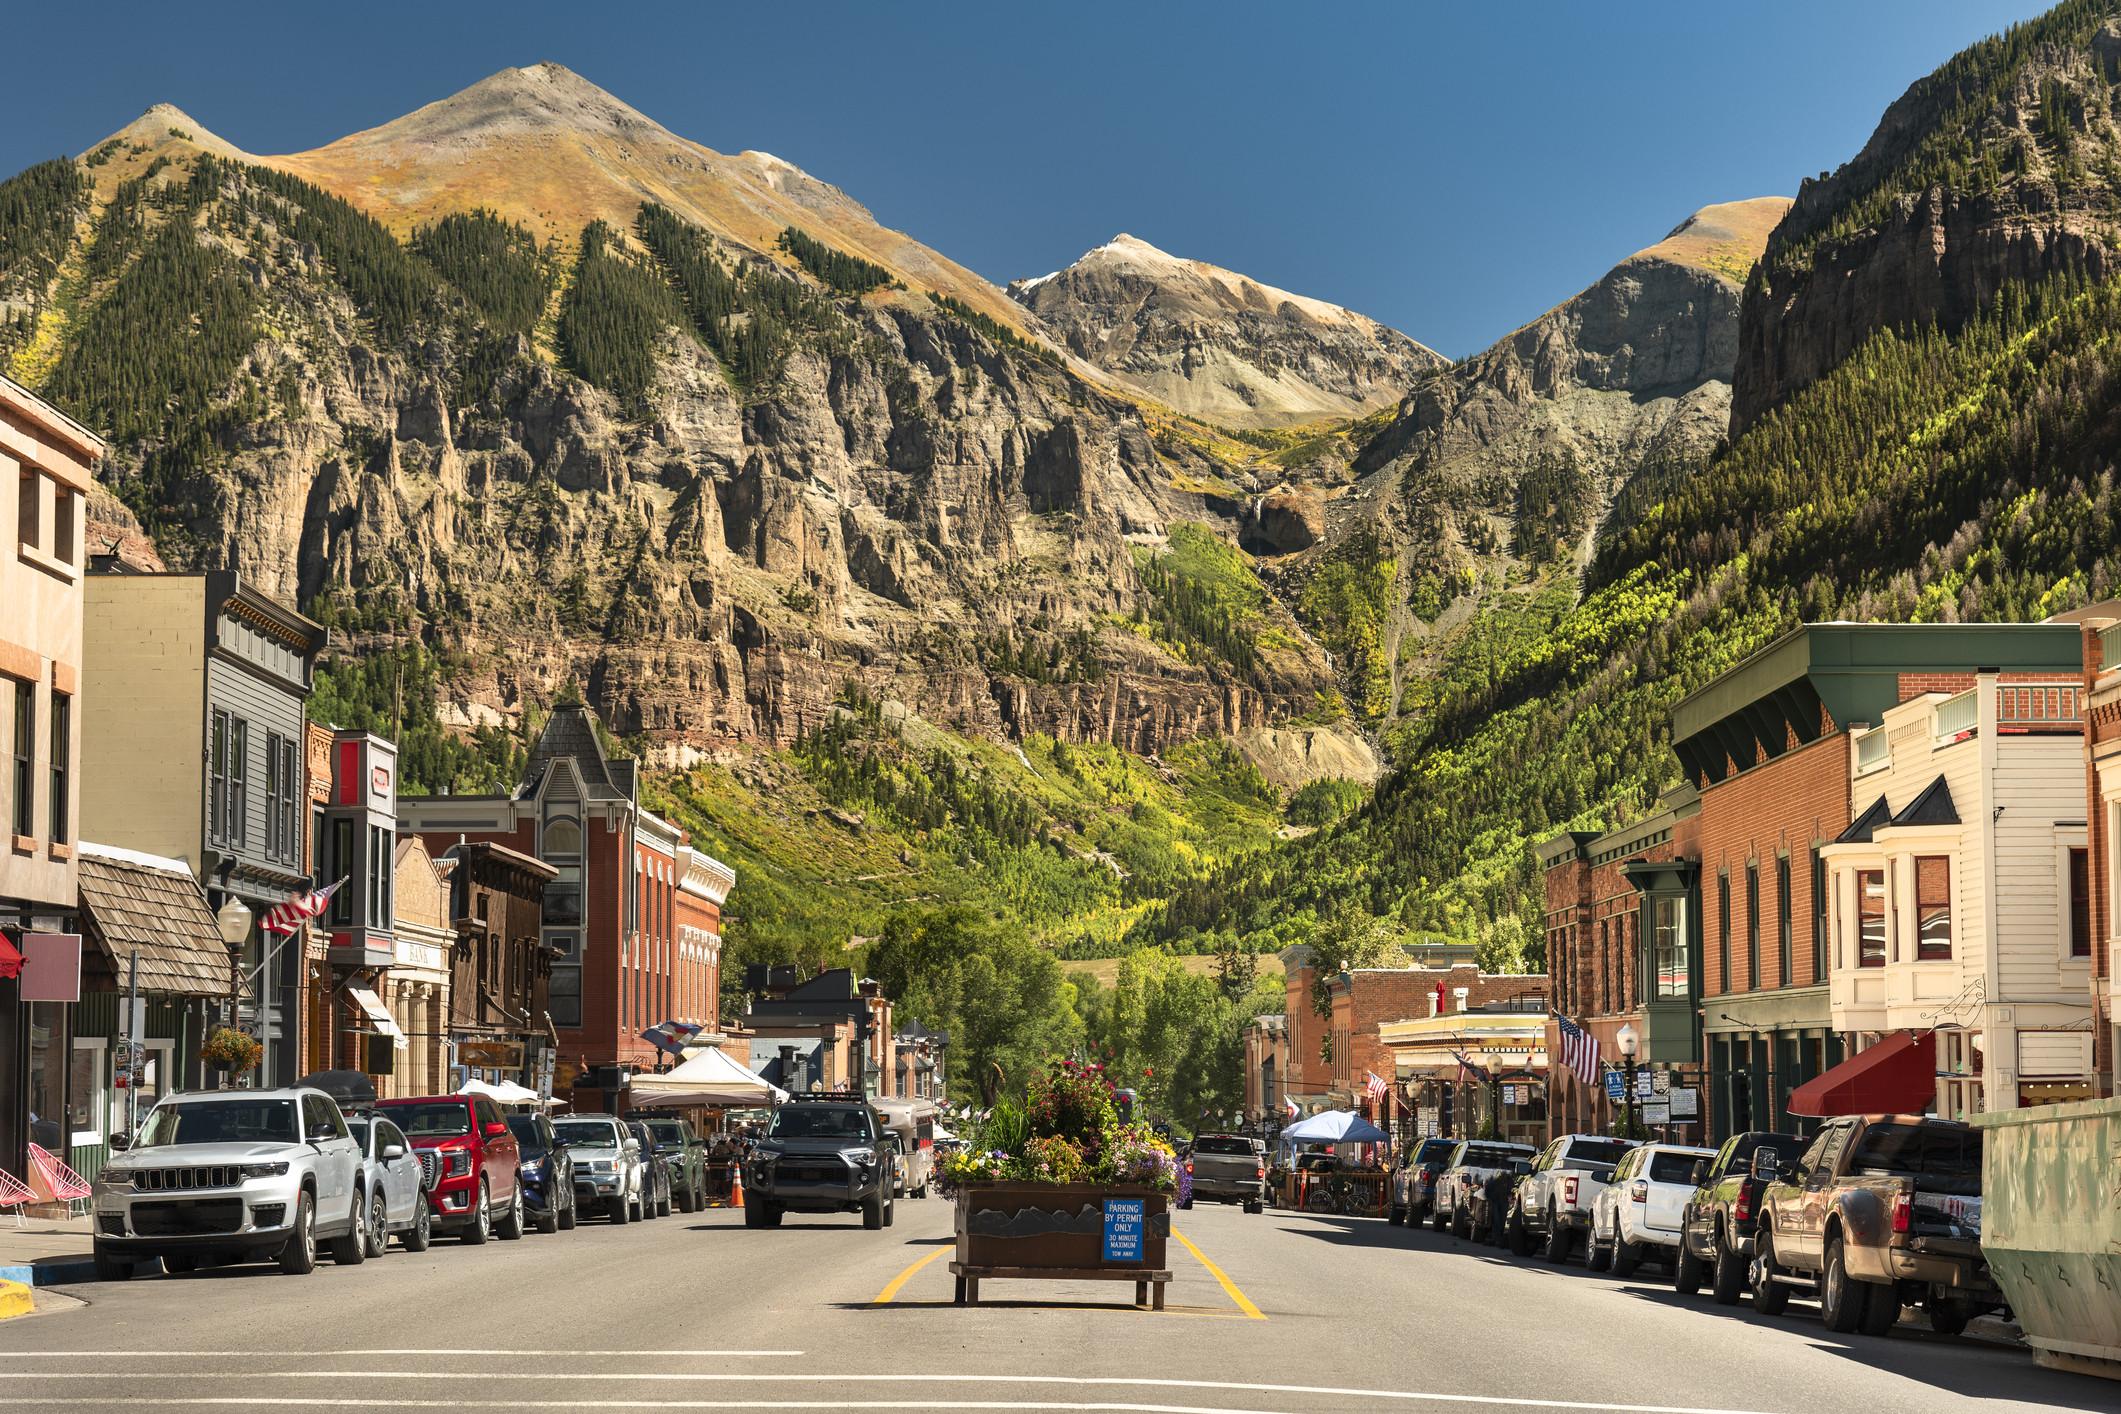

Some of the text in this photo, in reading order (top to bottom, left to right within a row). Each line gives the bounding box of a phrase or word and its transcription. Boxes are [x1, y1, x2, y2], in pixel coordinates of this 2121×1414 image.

[409, 944, 429, 964] BANK
[1109, 1204, 1139, 1213] PARKING
[1104, 1213, 1142, 1222] BY PERMIT
[1114, 1223, 1132, 1232] ONLY
[1118, 1234, 1138, 1242] MINUTE
